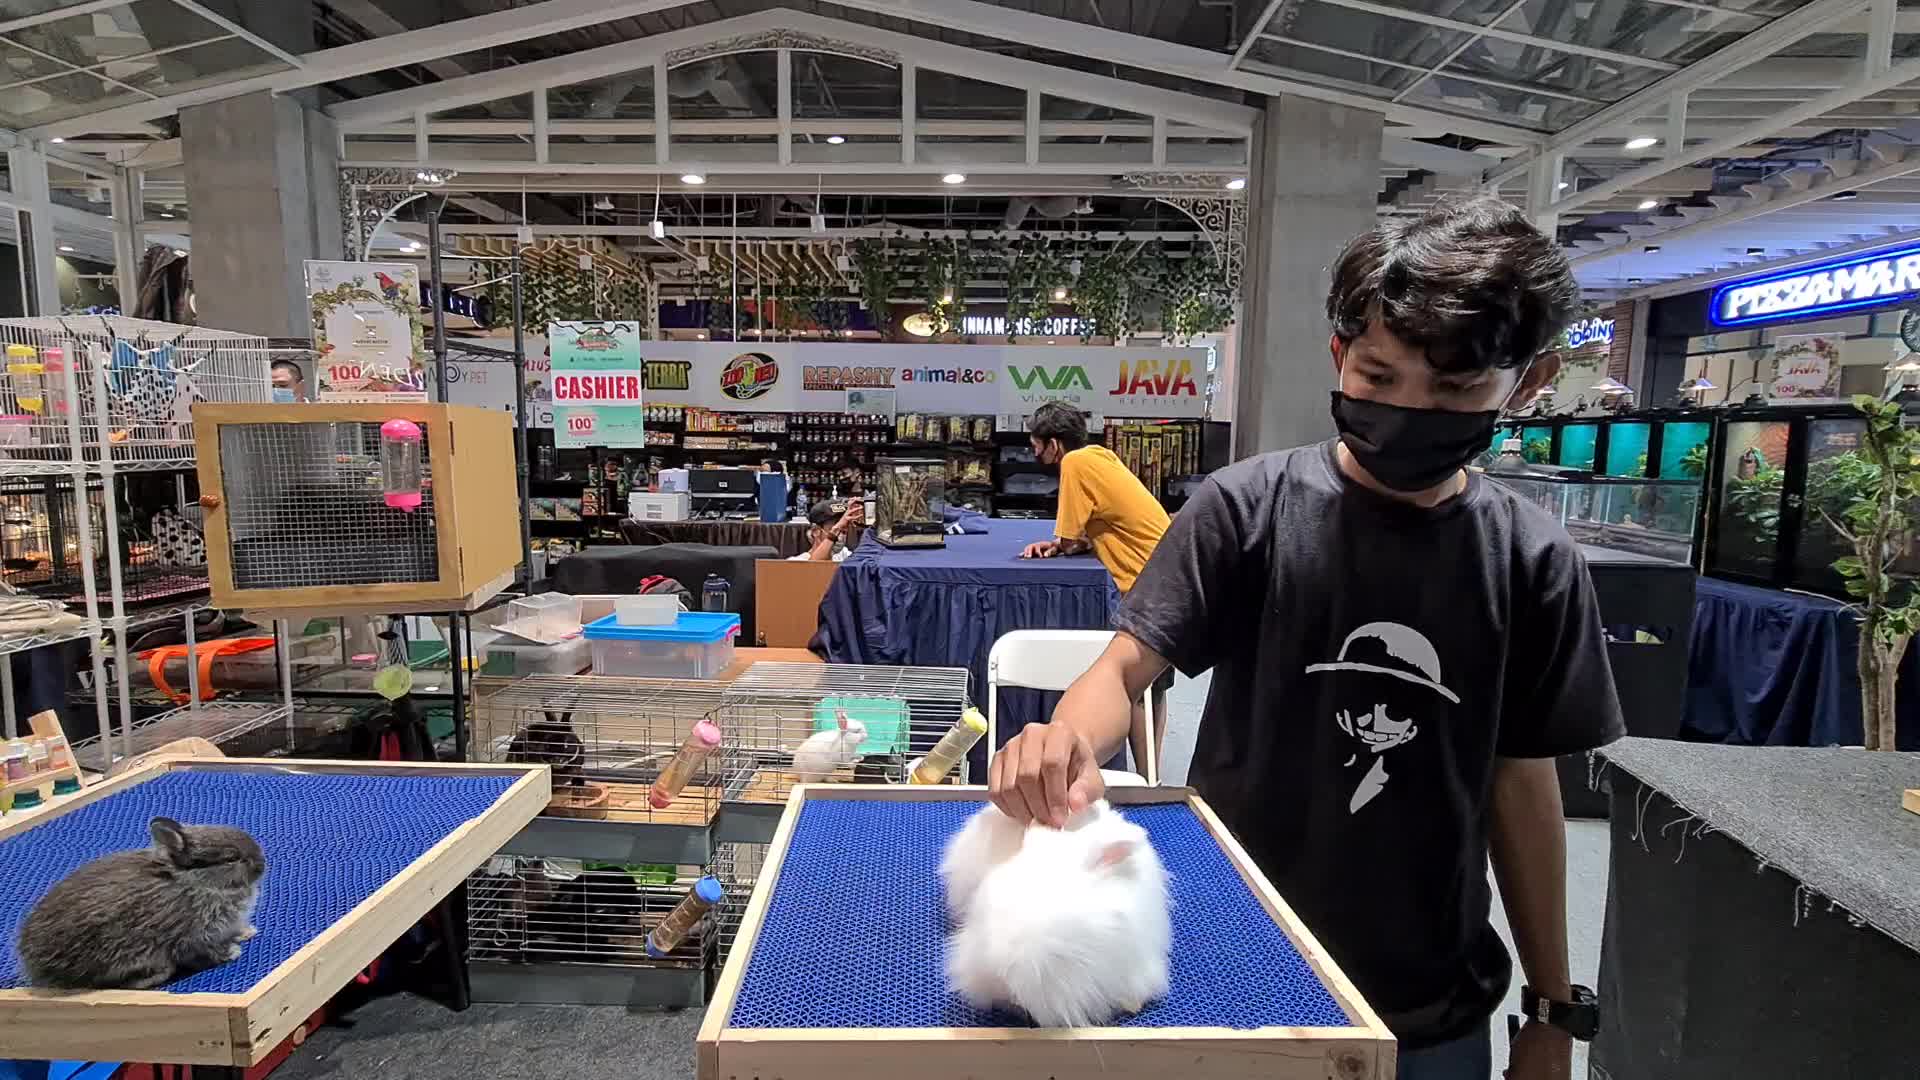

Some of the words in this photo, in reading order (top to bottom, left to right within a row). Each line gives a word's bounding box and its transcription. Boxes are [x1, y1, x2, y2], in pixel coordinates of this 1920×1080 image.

[956, 317, 1031, 335] INNAMNS
[328, 365, 361, 381] 100
[646, 361, 688, 389] TERRA
[803, 366, 895, 386] REPASHY
[902, 366, 996, 384] animal&co
[1109, 359, 1197, 395] JAVA
[555, 375, 638, 399] CASHIER
[568, 418, 592, 430] 100
